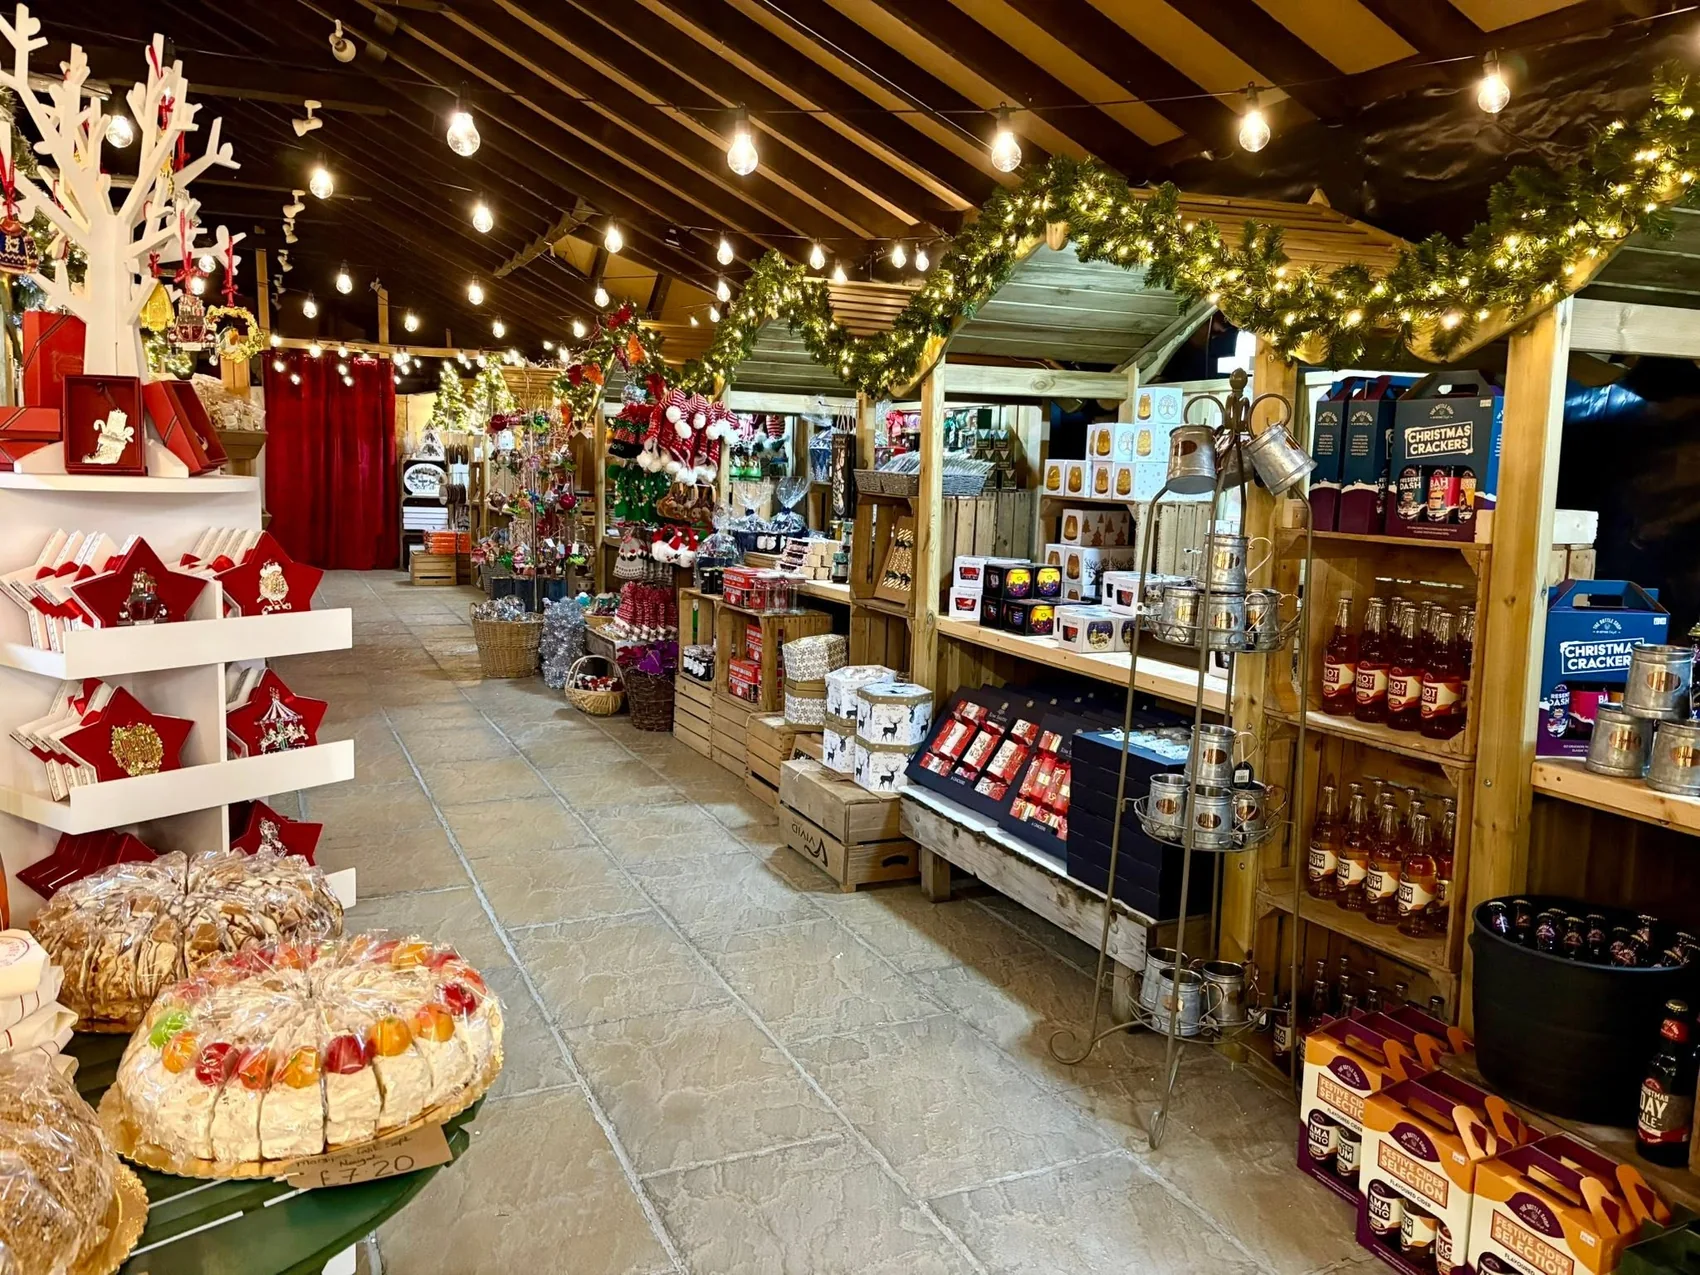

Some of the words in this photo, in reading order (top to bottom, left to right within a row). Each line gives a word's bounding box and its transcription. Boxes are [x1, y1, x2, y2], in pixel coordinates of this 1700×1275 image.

[1408, 425, 1471, 443] CHRISTMAS
[1410, 438, 1468, 455] CRACKERS
[1400, 482, 1422, 490] DASH
[1430, 477, 1448, 488] BAH
[1358, 672, 1374, 684] HOT
[1388, 679, 1406, 690] HOT
[792, 824, 816, 848] VIVID
[1338, 866, 1348, 878] UM
[1321, 1078, 1348, 1100] FESTIVE
[1640, 1090, 1668, 1120] DAY
[1327, 1108, 1350, 1126] FLAVOURED
[1310, 1124, 1328, 1139] AMA
[1382, 1146, 1414, 1171] FESTIVE
[1416, 1167, 1444, 1190] CIDER
[1381, 1155, 1444, 1202] SELECTION
[1390, 1178, 1416, 1199] FLAVOURED
[1416, 1196, 1432, 1208] CIDER
[1370, 1194, 1389, 1212] AMA
[1494, 1226, 1568, 1275] SELECTION
[1496, 1216, 1535, 1246] FESTIVE
[1536, 1244, 1570, 1270] CIDER
[1504, 1252, 1536, 1275] FLAVOURED
